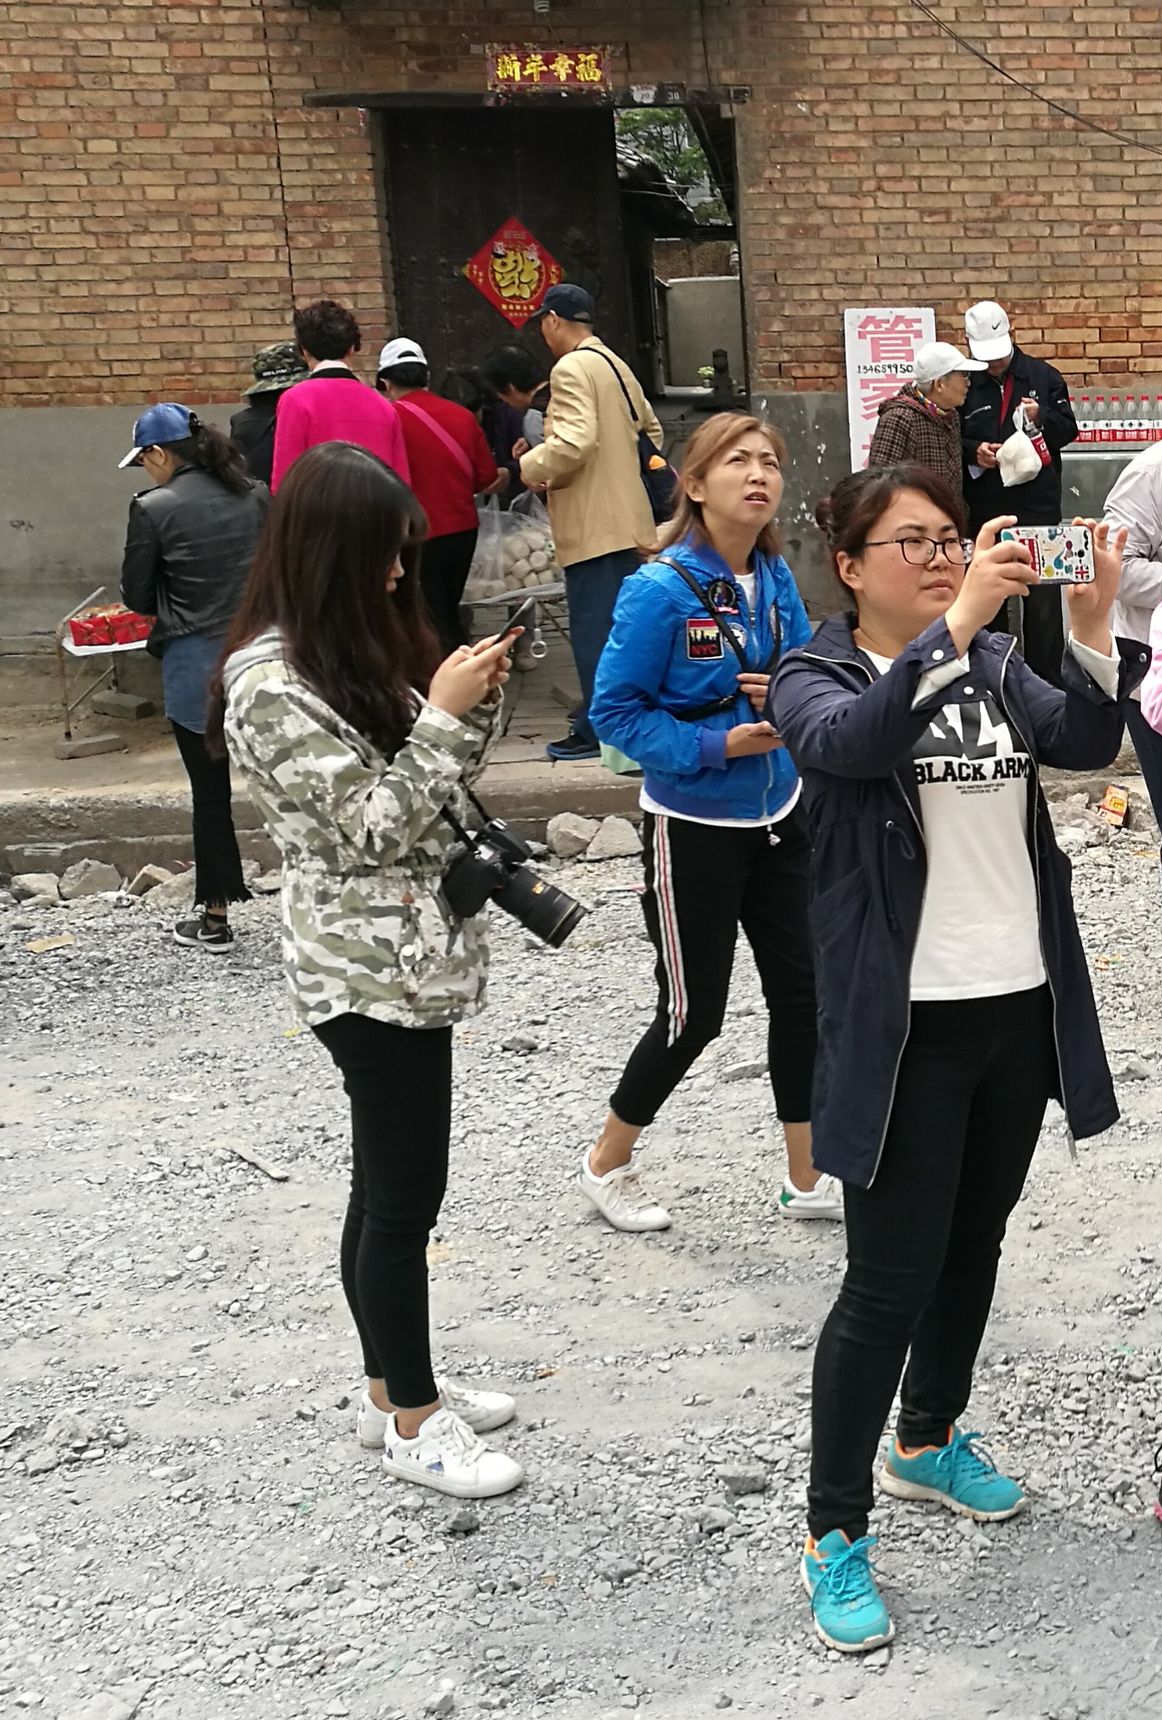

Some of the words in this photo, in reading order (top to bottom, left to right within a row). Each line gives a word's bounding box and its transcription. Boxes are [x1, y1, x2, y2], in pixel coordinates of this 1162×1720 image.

[497, 53, 602, 82] 新年幸福
[691, 643, 719, 655] NYC
[913, 760, 987, 786] BLACK
